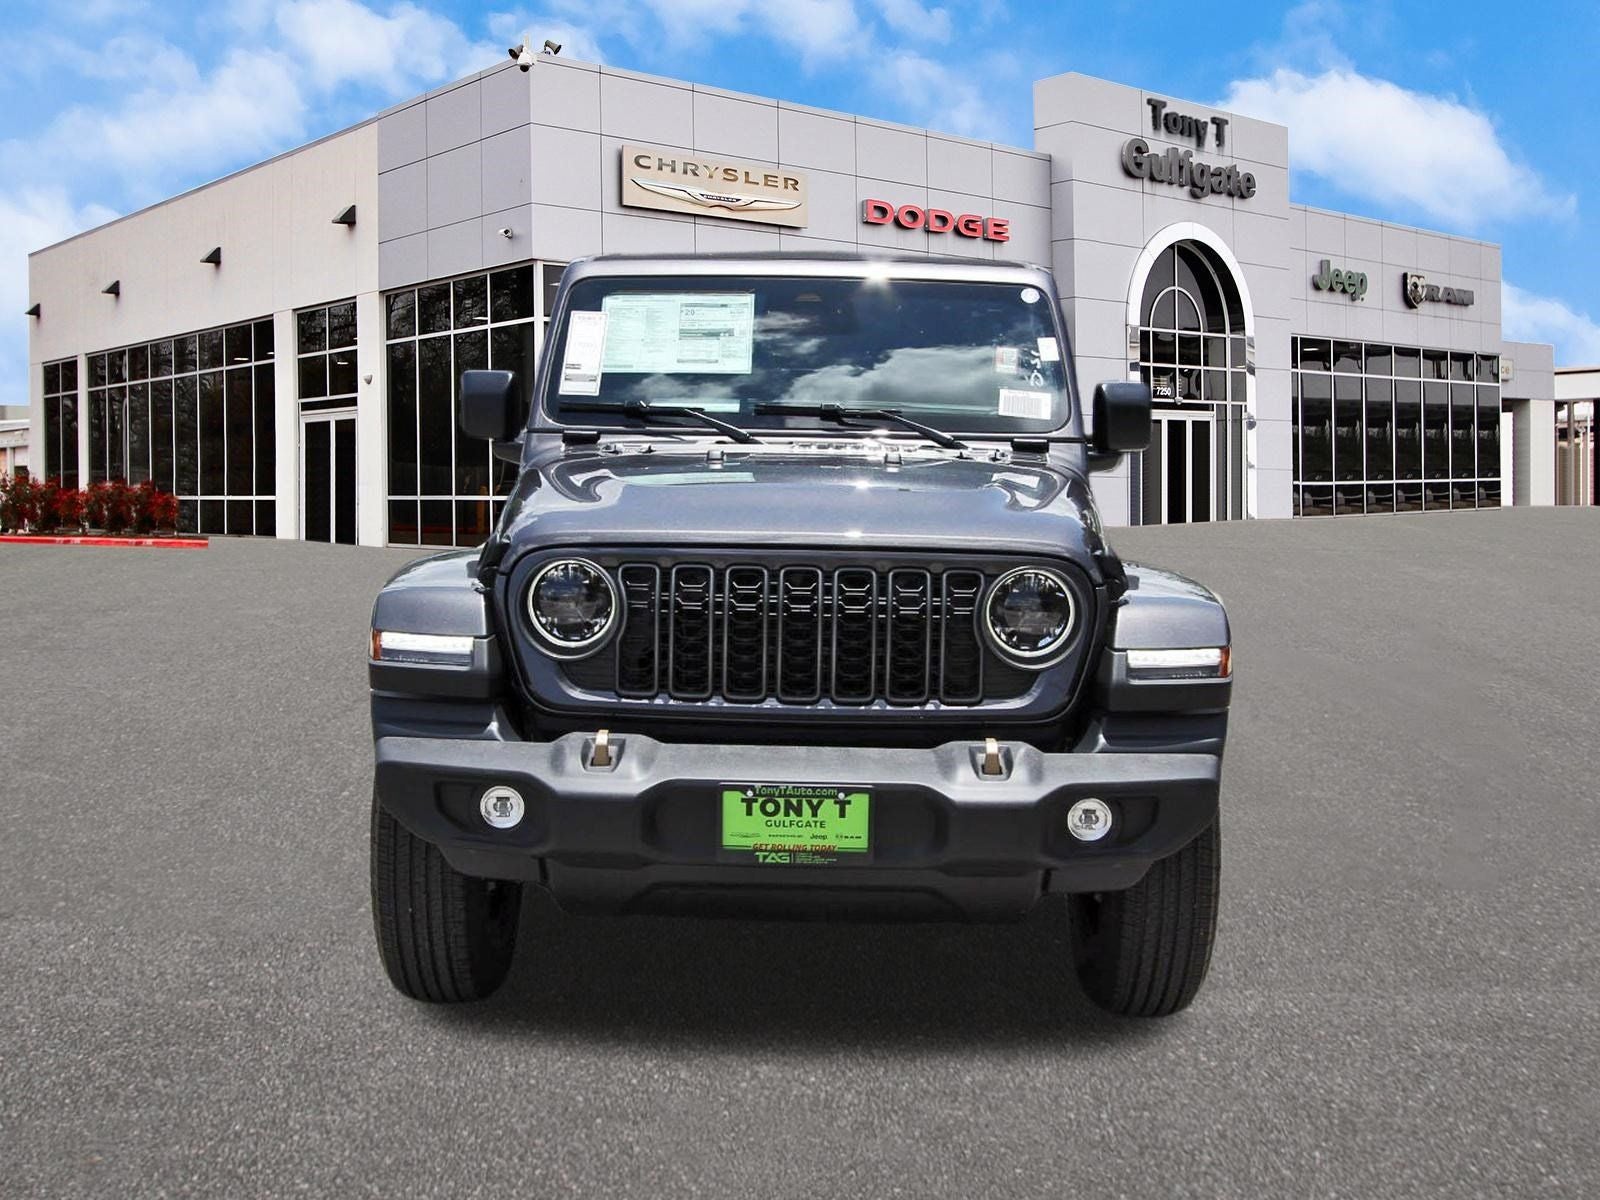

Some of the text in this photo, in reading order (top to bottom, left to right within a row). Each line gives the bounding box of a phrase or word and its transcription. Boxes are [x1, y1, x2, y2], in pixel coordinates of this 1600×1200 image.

[1146, 98, 1229, 148] Tony T
[633, 154, 800, 191] CHRYSLER
[1121, 138, 1256, 199] Gulfgate
[862, 199, 1010, 242] DODGE
[1312, 259, 1368, 301] Jeep
[1424, 284, 1474, 306] RAM
[1156, 386, 1172, 396] 7250
[754, 785, 838, 797] TonyTAuto.com
[740, 798, 851, 818] TONY T
[765, 819, 827, 829] GULFGATE
[752, 843, 838, 852] GET ROLLING TODAY
